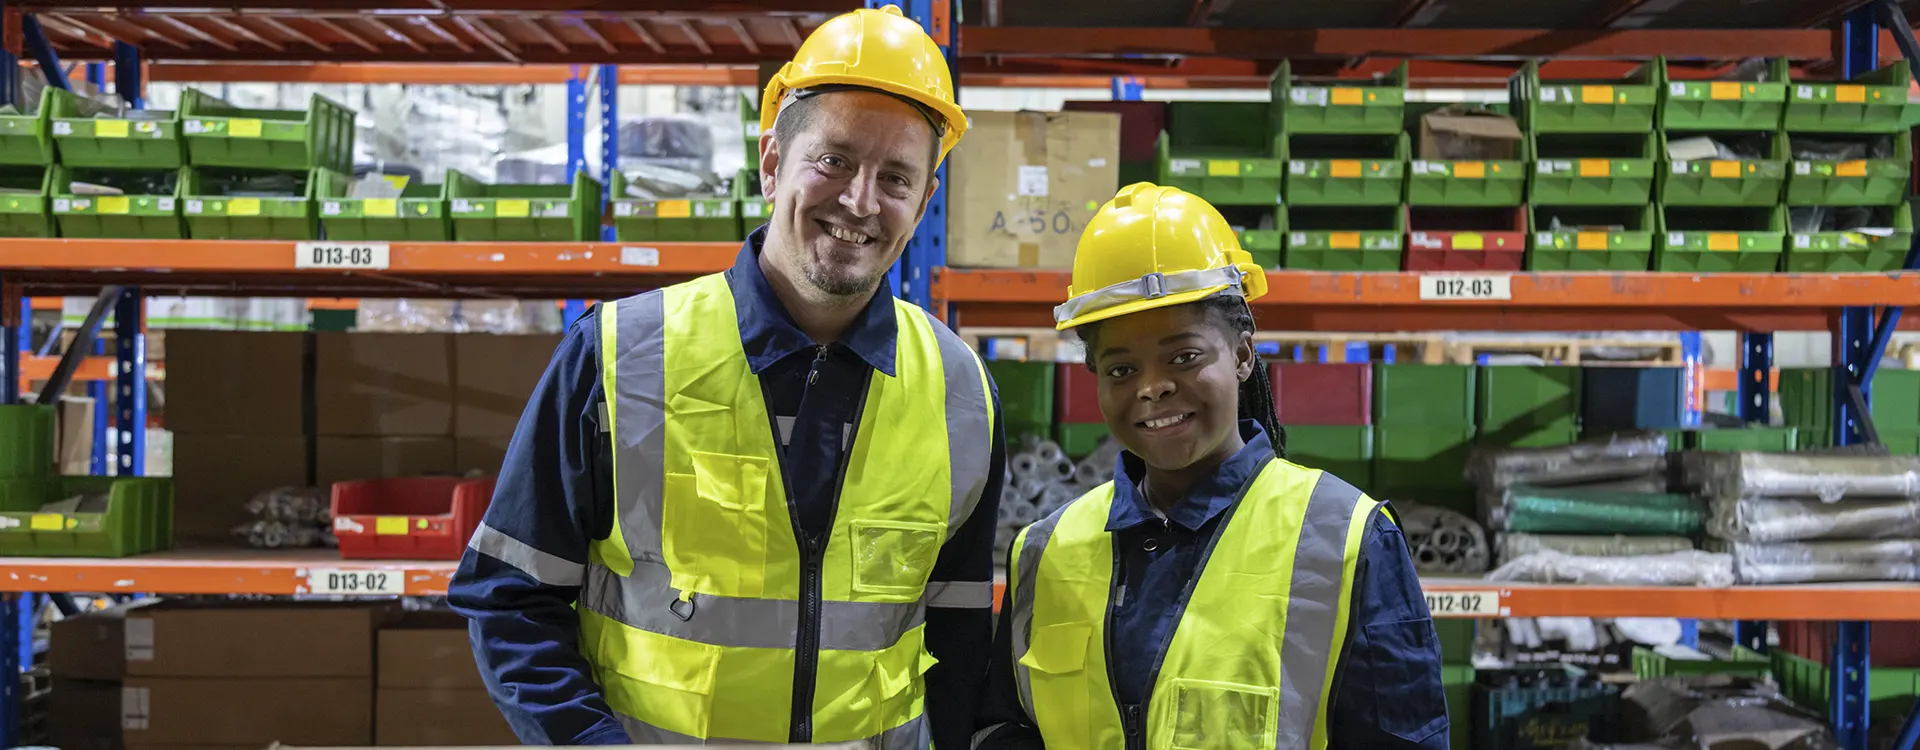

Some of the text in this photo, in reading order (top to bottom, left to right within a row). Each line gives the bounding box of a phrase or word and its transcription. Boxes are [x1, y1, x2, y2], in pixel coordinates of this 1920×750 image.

[313, 247, 372, 265] D13-03
[1436, 279, 1493, 296] D12-03
[328, 573, 387, 591] D13-02
